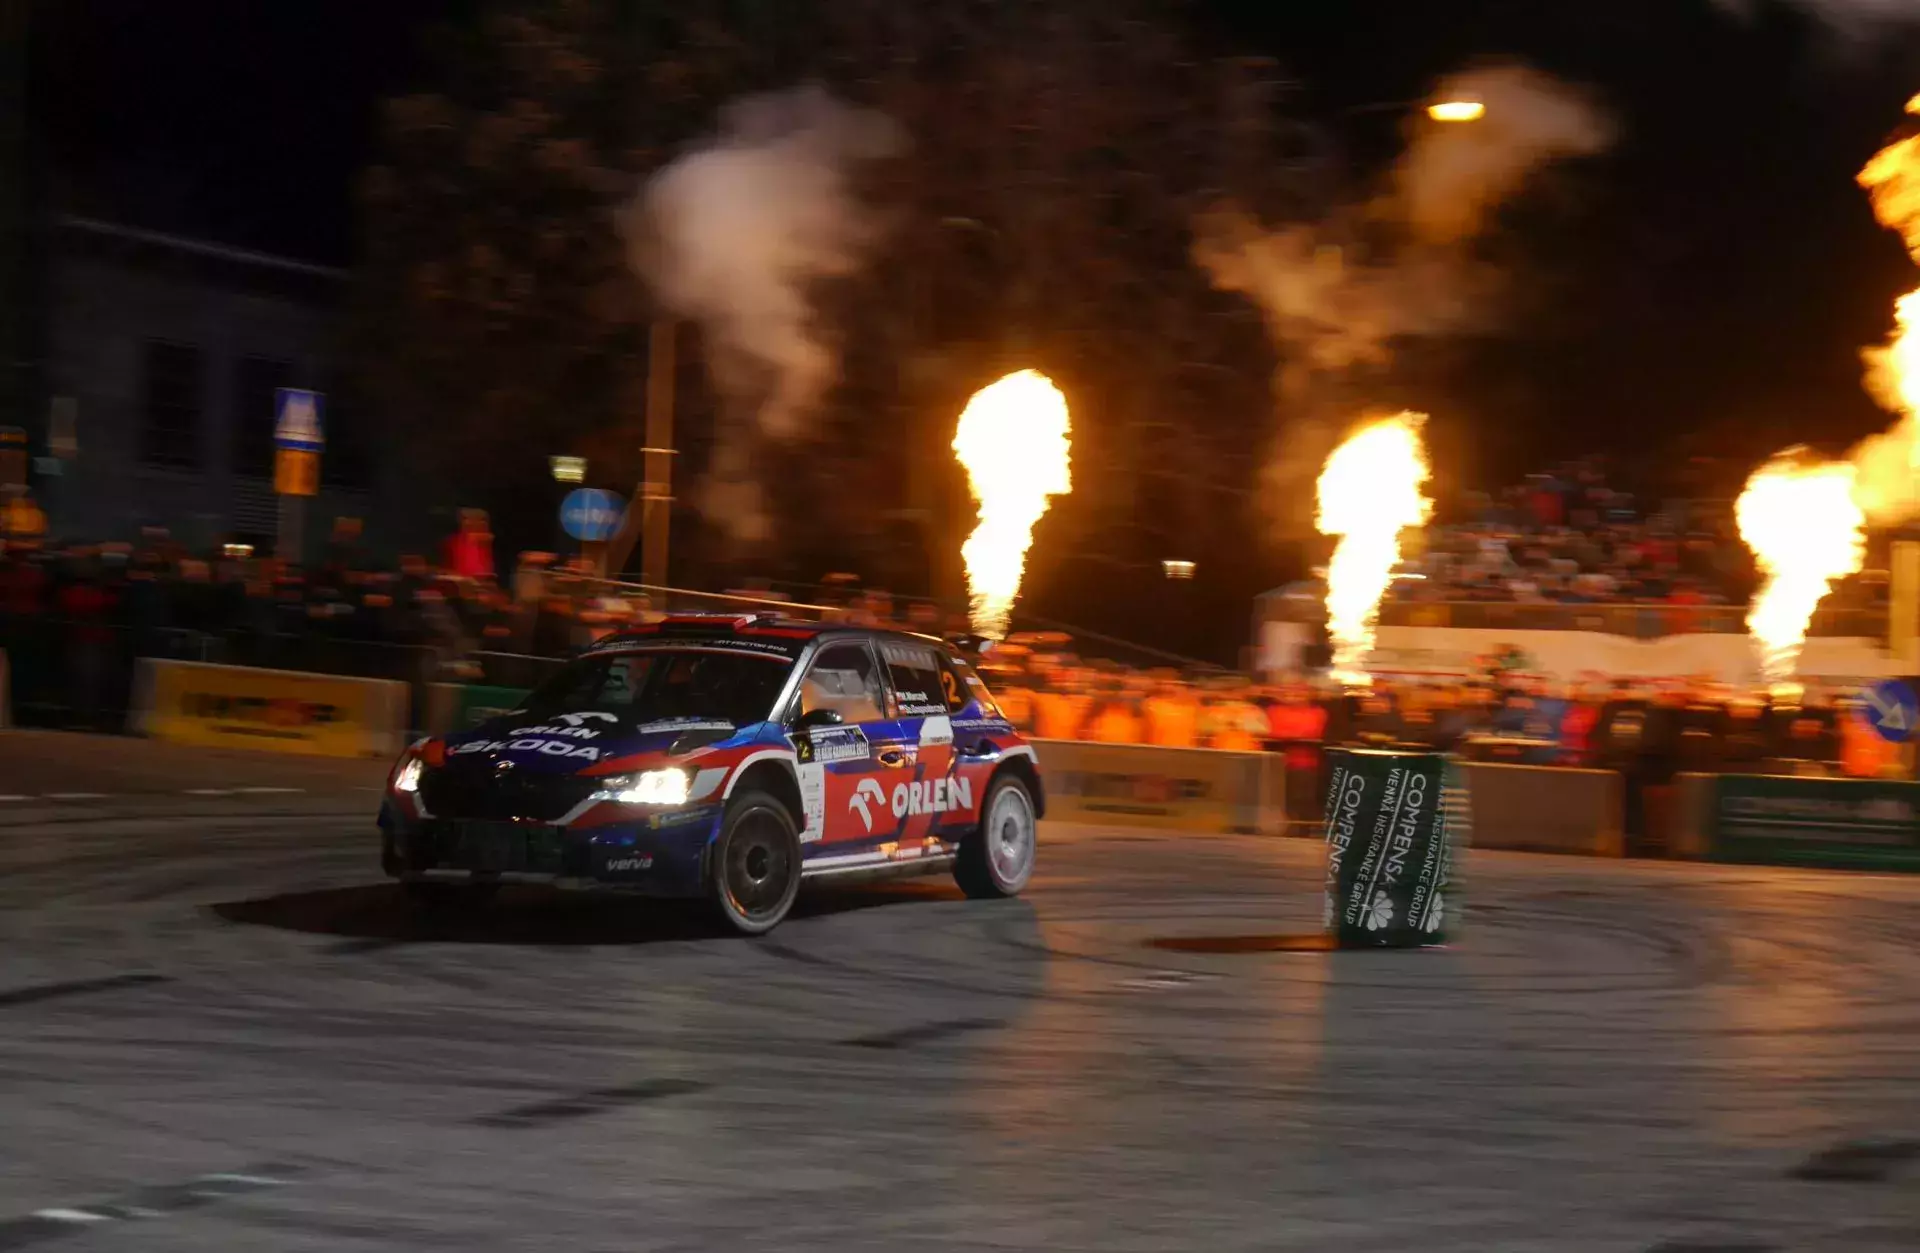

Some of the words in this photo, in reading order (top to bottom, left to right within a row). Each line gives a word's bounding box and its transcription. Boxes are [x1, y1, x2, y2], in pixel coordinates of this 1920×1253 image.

[943, 671, 962, 704] 2
[509, 726, 602, 740] ORLEN
[800, 741, 810, 759] 2
[892, 777, 973, 817] ORLEN
[1326, 766, 1343, 809] VIENNA
[1381, 767, 1401, 812] VIENNA
[1325, 774, 1365, 884] COMPENSA
[1357, 814, 1388, 882] INSURANCE
[1384, 773, 1427, 884] COMPENSA
[1419, 813, 1442, 886] INSURANCE
[607, 857, 653, 873] verva
[1344, 882, 1364, 925] GROUP
[1408, 884, 1427, 927] GROUP
